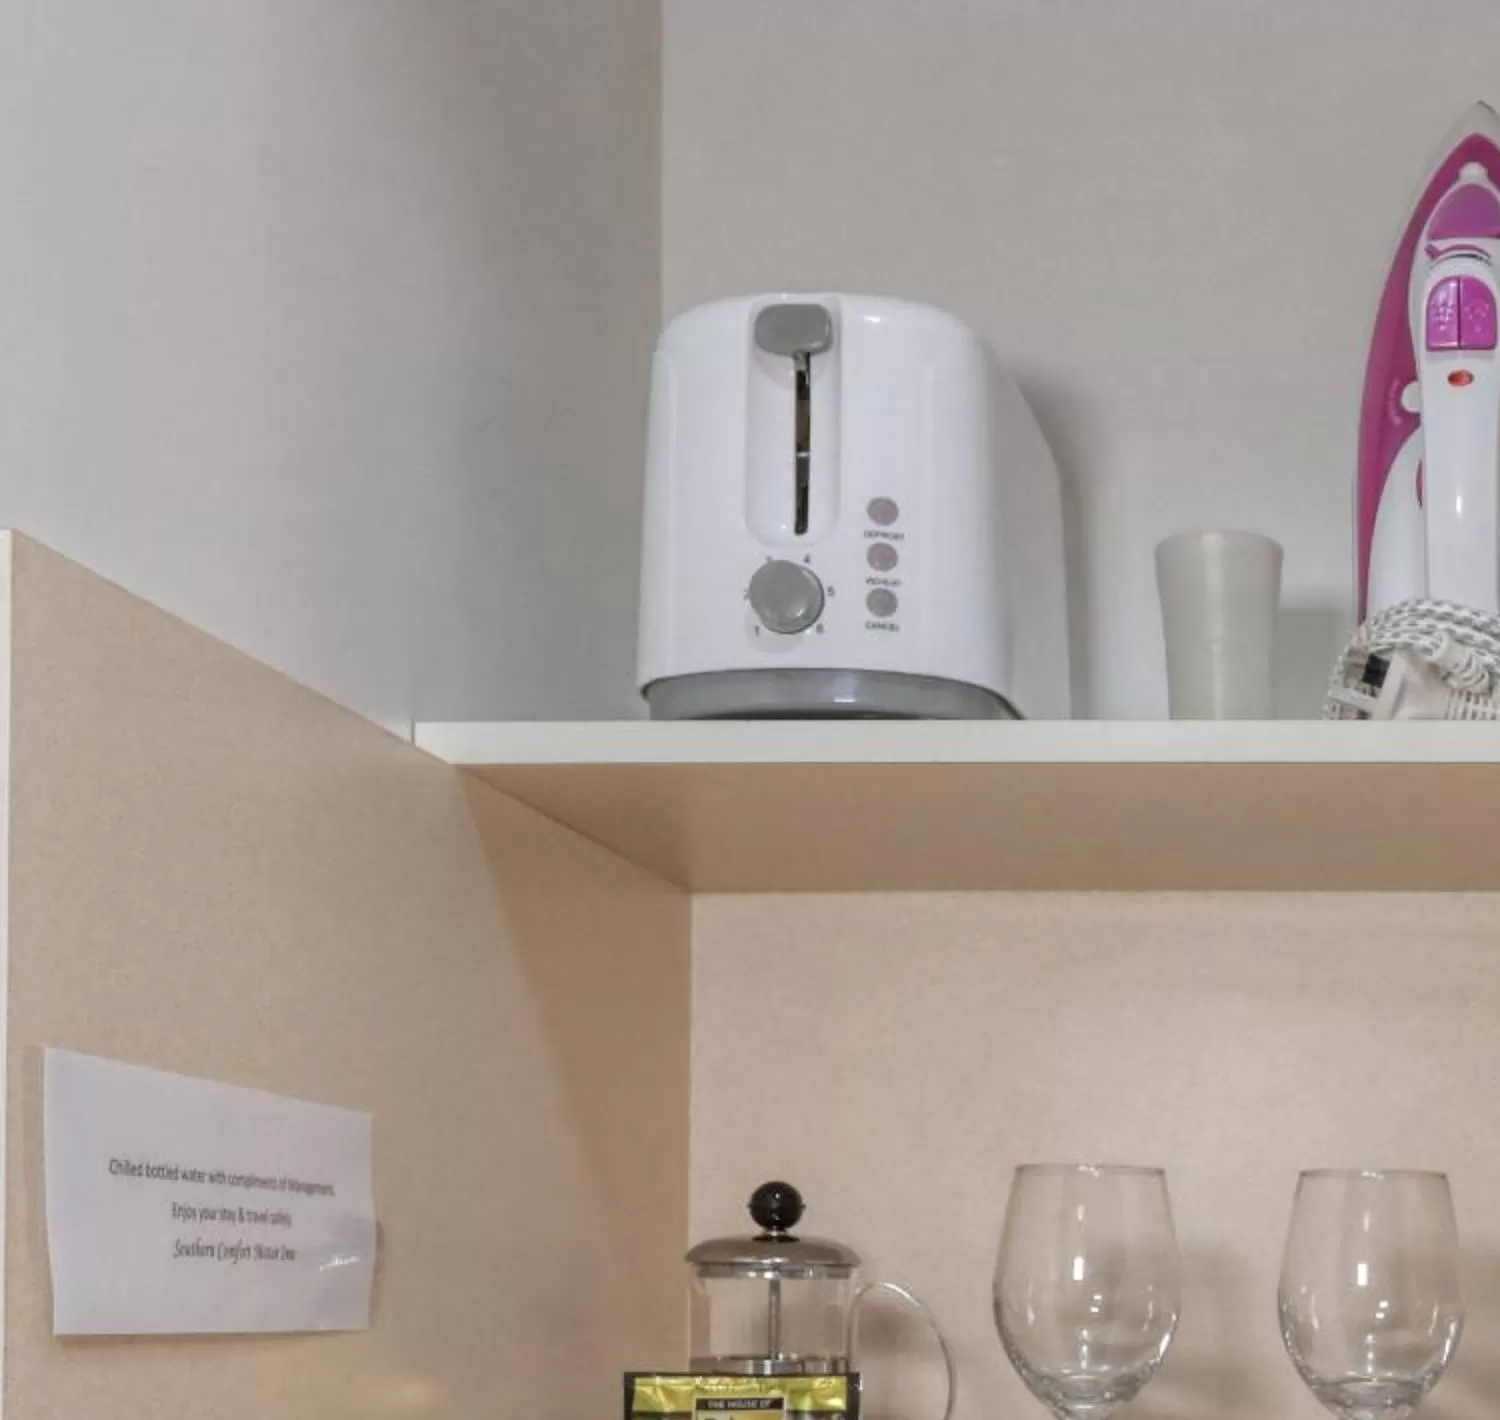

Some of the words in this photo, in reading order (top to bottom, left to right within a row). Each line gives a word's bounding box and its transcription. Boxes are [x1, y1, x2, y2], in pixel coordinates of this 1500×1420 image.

[109, 1158, 144, 1176] Chilled
[145, 1162, 179, 1180] bottled
[180, 1168, 205, 1184] water
[172, 1202, 197, 1224] Enjoy
